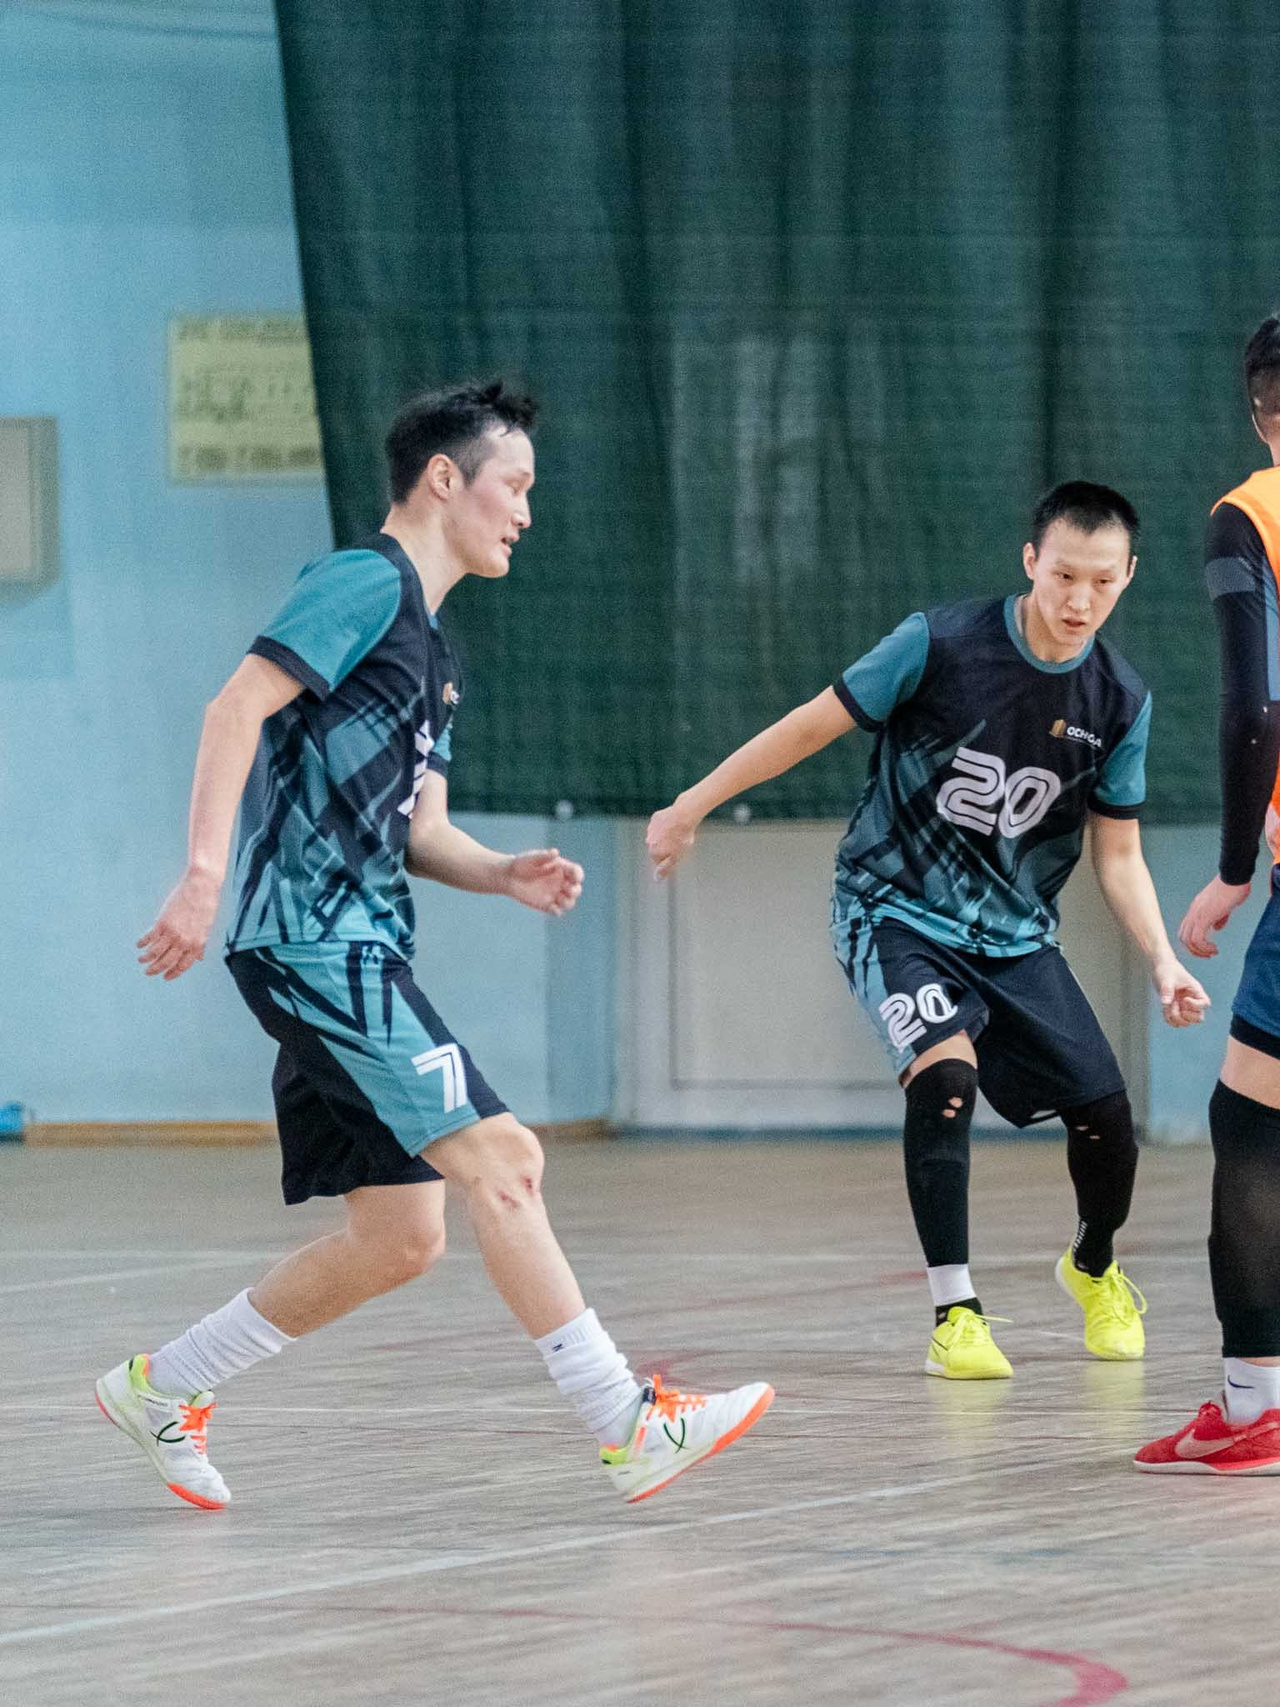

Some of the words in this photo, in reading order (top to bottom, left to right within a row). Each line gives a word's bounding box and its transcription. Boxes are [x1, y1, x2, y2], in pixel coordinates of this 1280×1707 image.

[935, 746, 1062, 839] 20
[878, 982, 959, 1054] 20
[410, 1043, 468, 1114] 7
